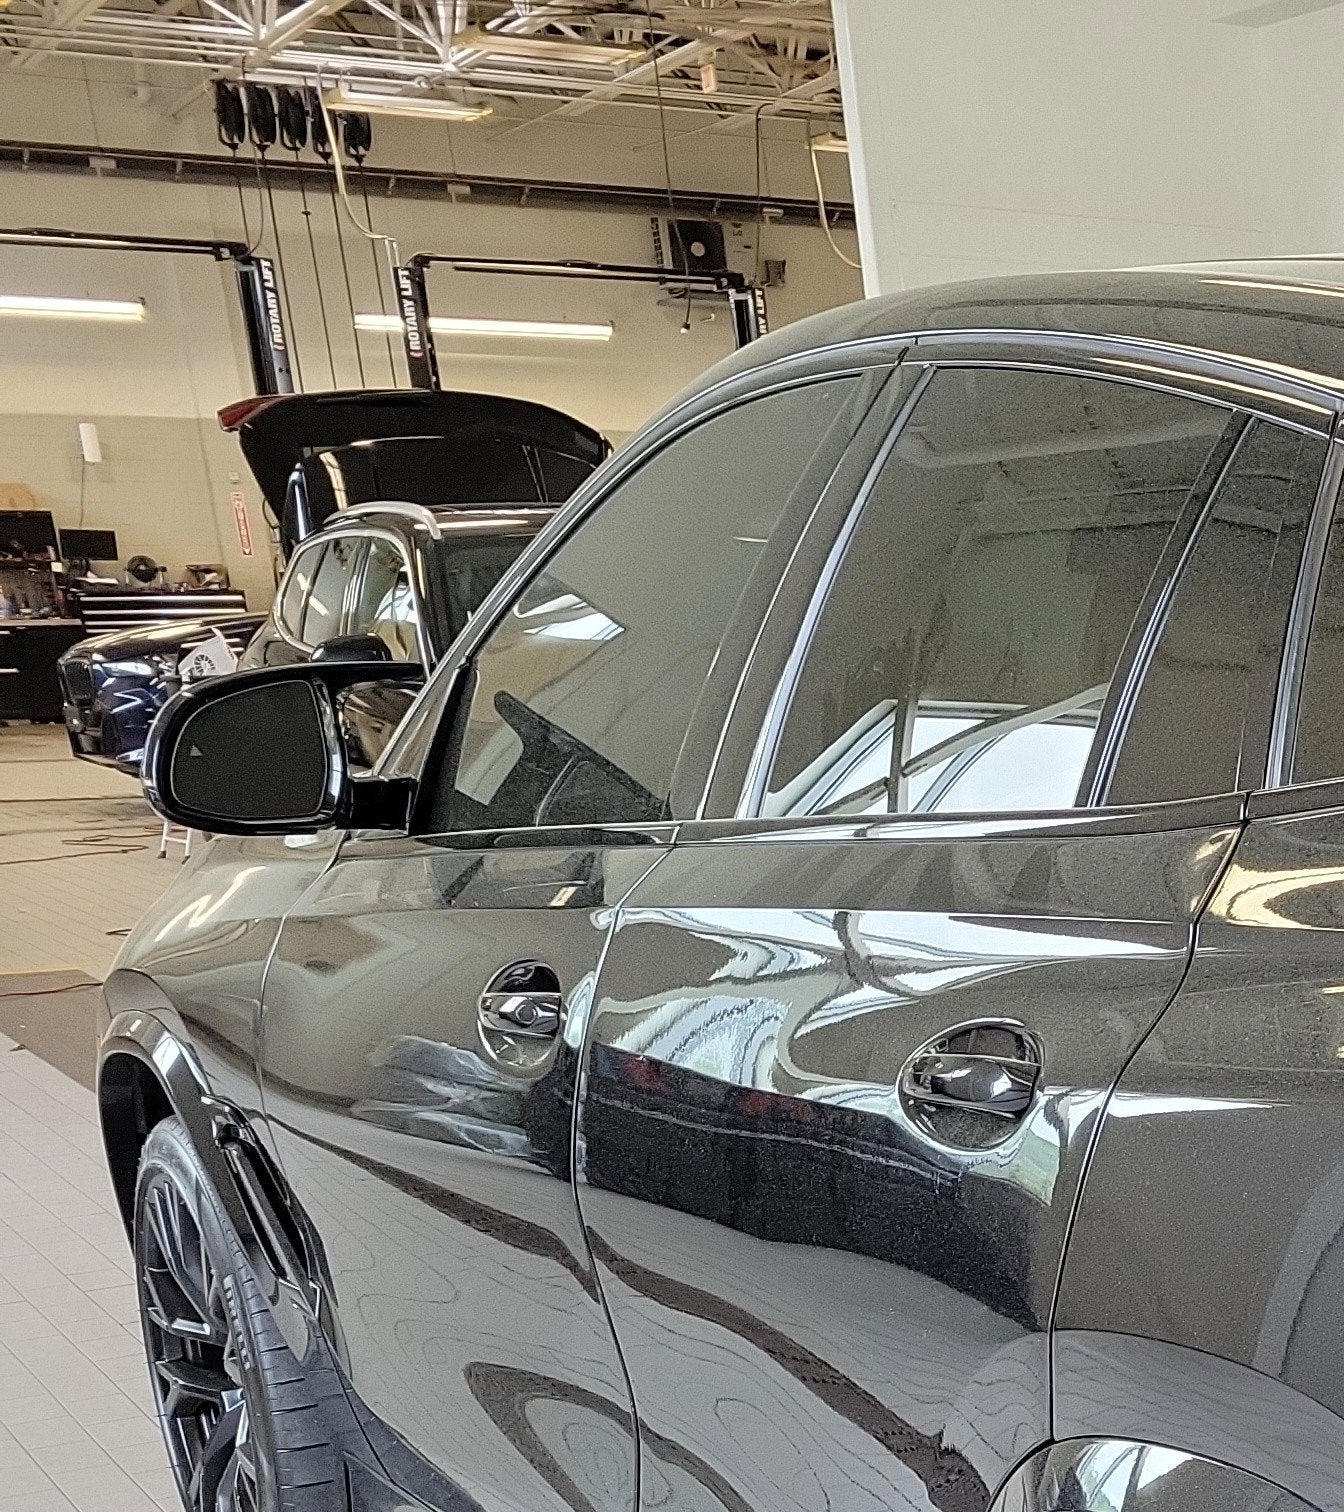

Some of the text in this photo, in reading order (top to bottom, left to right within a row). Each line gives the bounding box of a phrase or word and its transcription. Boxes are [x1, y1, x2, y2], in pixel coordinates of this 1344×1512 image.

[260, 259, 284, 344] ROTARY LIFT
[397, 268, 422, 351] ROTARY LIFT
